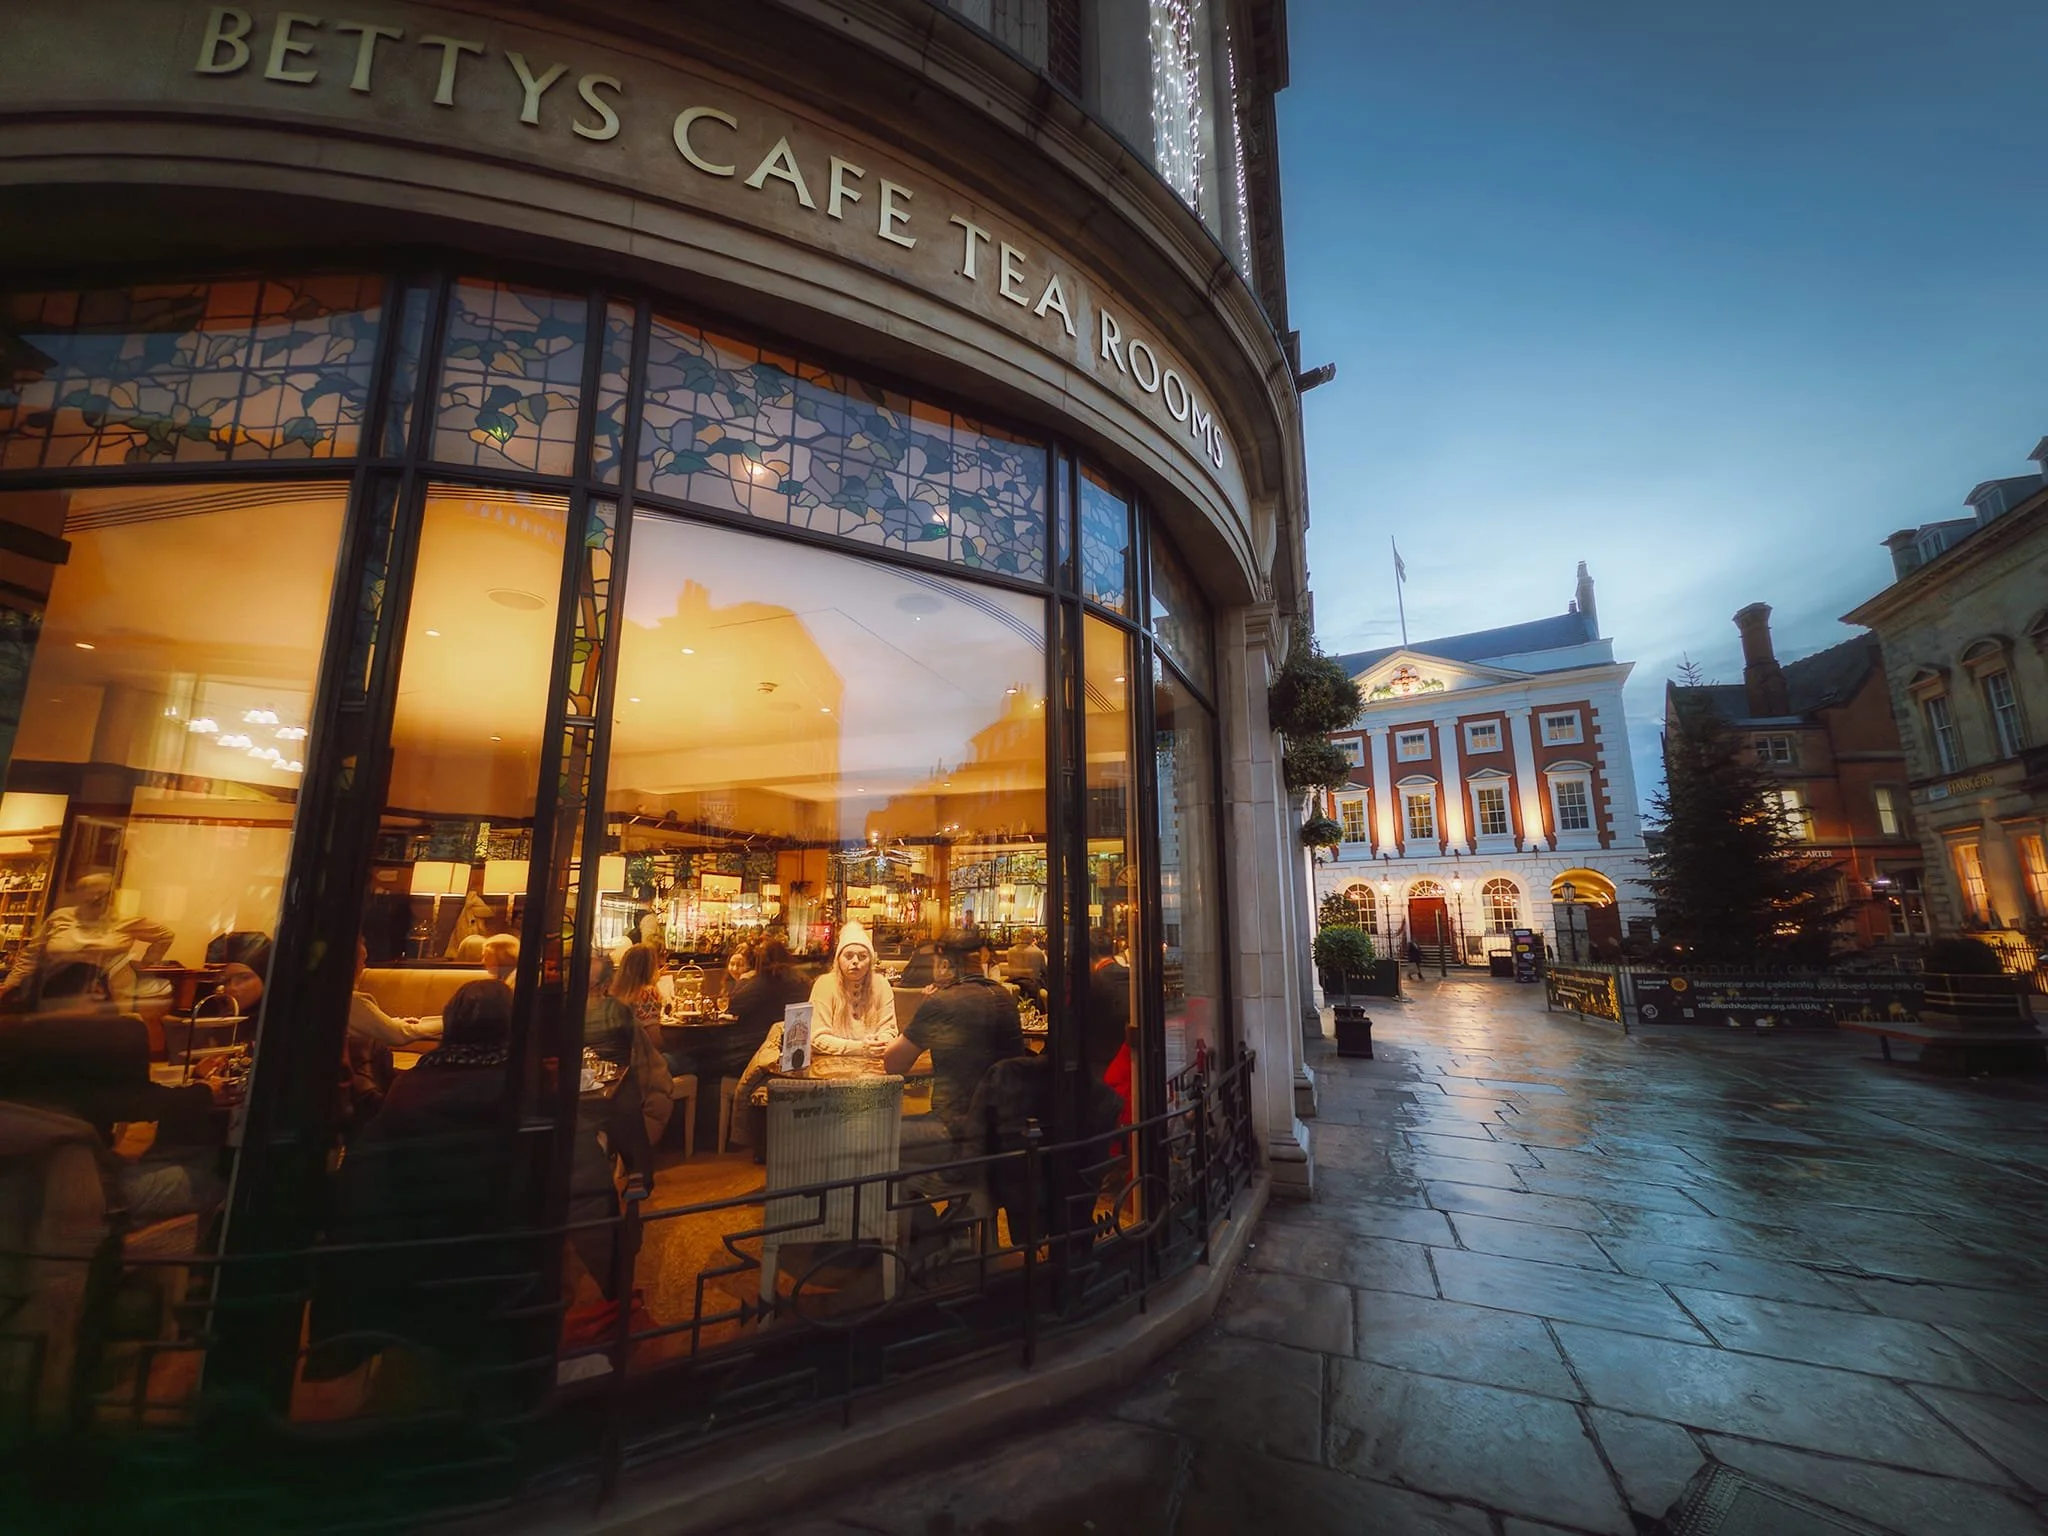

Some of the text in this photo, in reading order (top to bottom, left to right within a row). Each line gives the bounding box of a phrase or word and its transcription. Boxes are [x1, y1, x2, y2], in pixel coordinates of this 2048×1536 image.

[195, 5, 1225, 470] BETTYS CAFE TEA ROOMS
[1693, 980, 1743, 989] Remember
